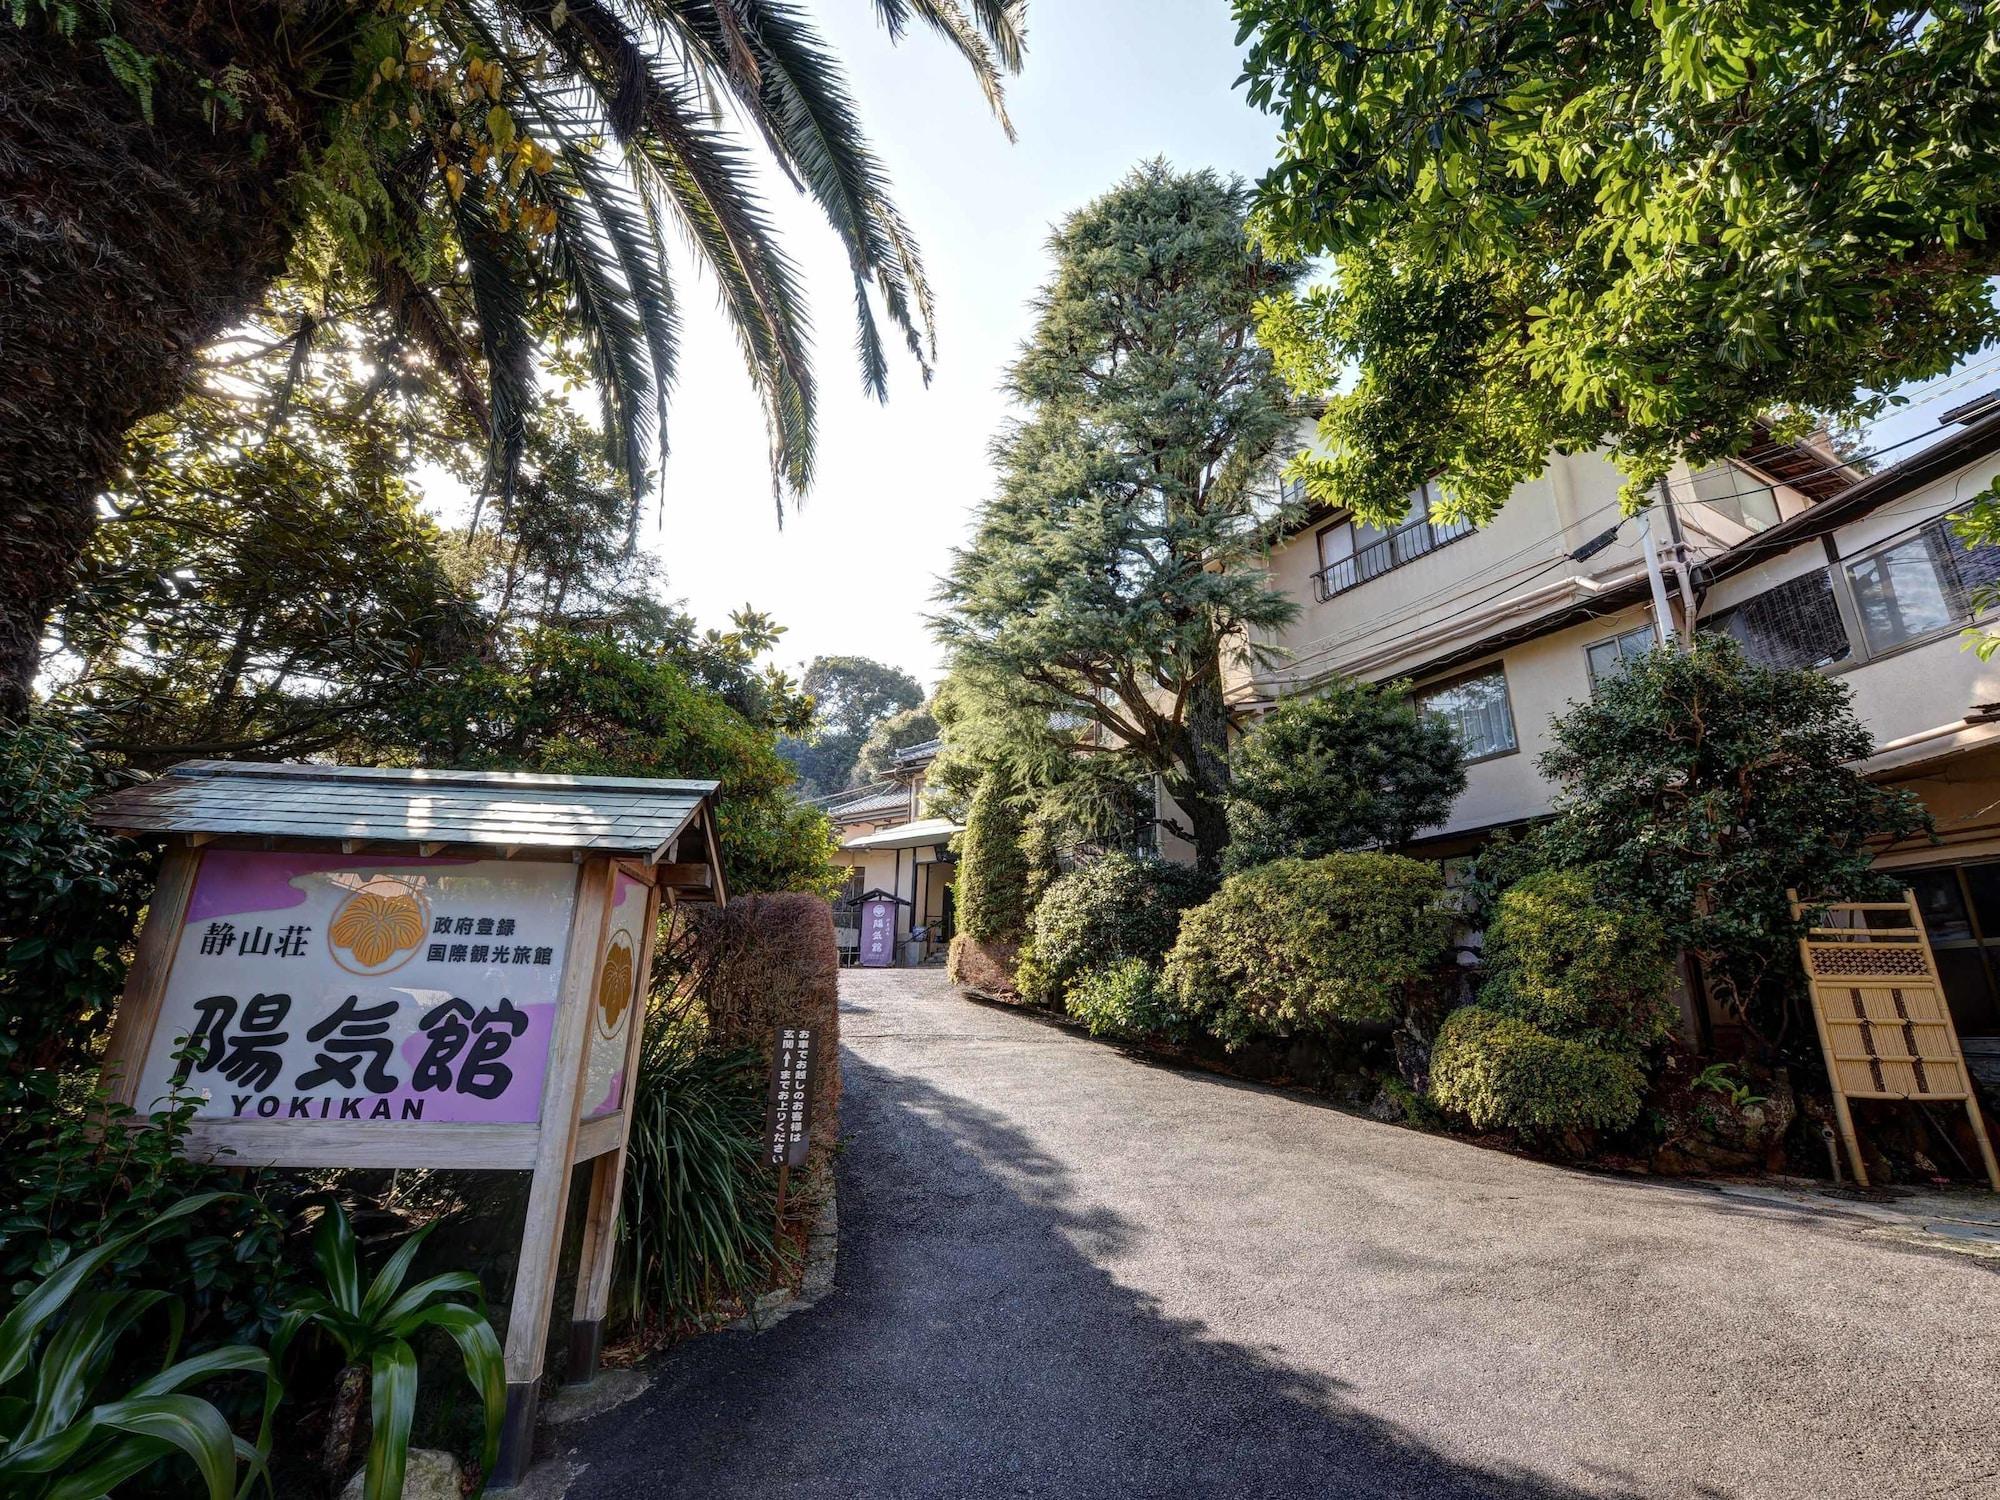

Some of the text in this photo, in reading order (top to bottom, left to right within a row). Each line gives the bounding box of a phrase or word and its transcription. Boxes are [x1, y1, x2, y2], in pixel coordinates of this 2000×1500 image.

[200, 923, 312, 957] 静山荘
[433, 917, 516, 937] 政府登録
[427, 944, 553, 965] 国際観光旅館
[173, 993, 529, 1100] 陽気館
[790, 1030, 810, 1142] お車でお越しのお客様は
[231, 1095, 425, 1120] YOKIKAN
